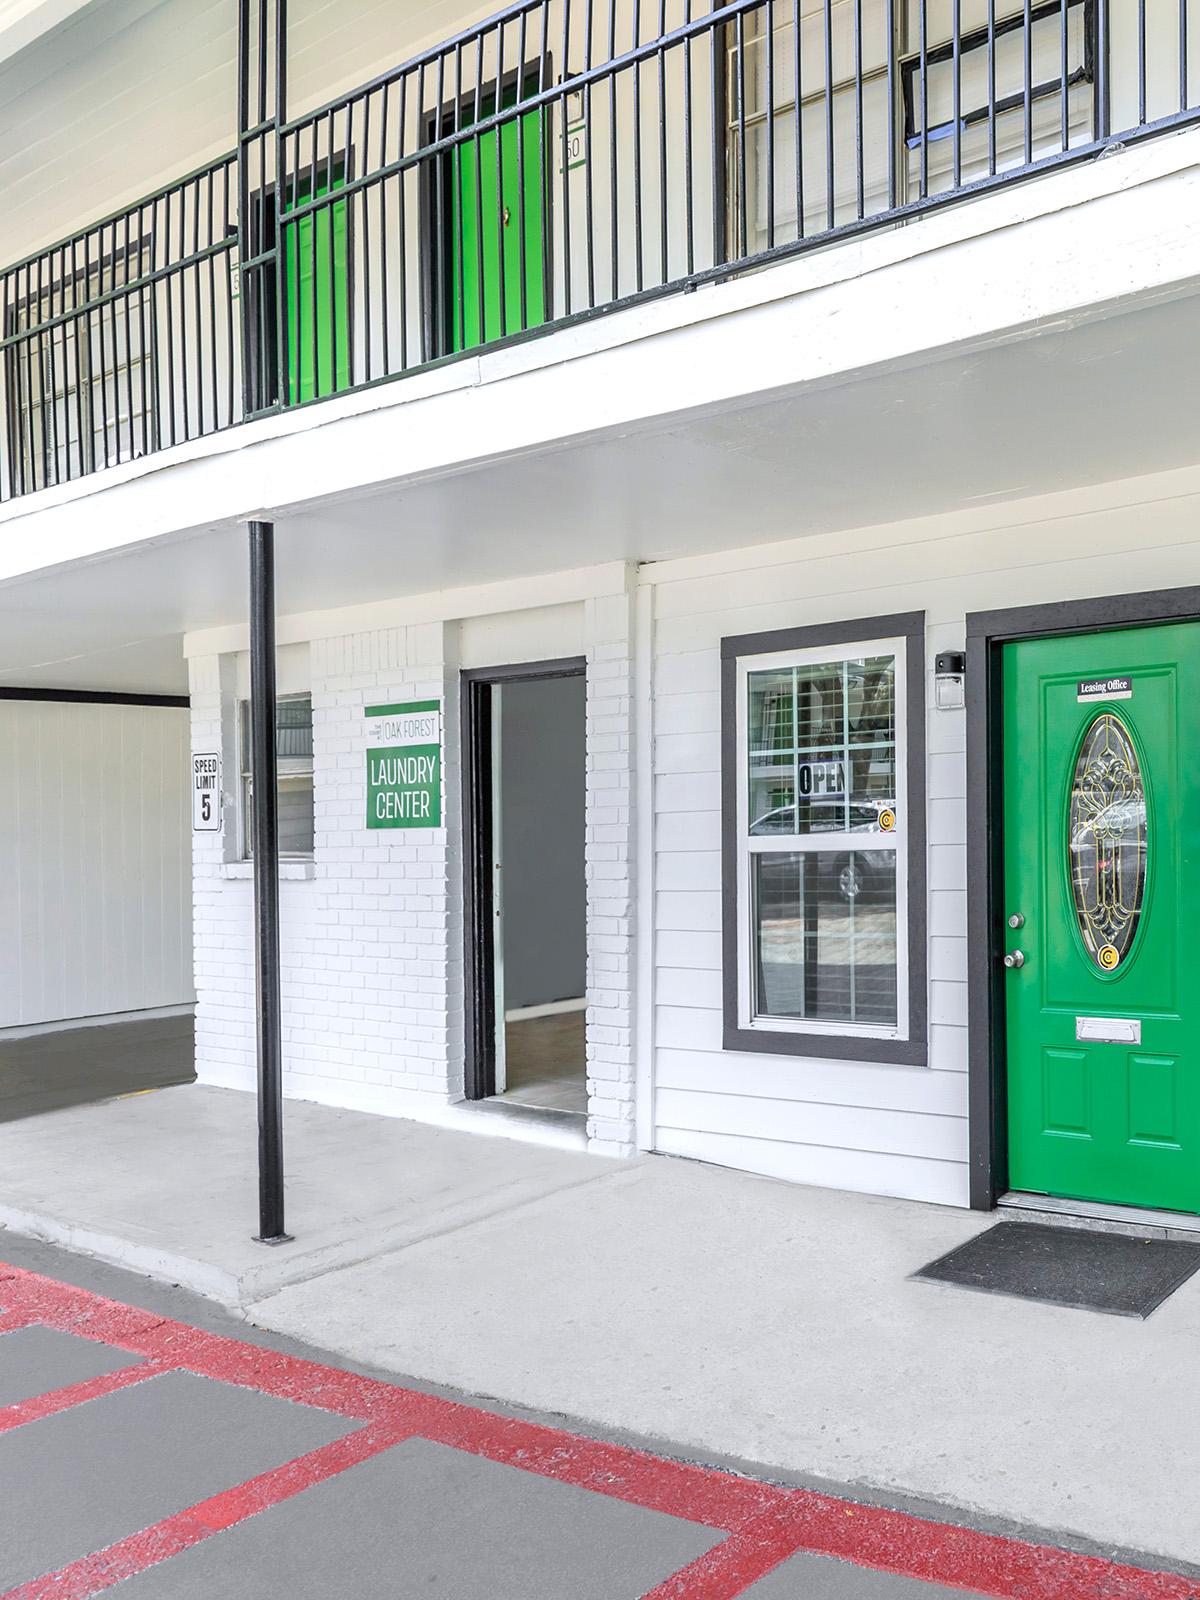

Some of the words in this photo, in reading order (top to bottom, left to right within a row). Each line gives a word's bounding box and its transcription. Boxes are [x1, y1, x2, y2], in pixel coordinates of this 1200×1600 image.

[1080, 682, 1107, 694] Leasing
[1107, 679, 1128, 690] Office
[385, 722, 402, 740] OAK
[404, 718, 435, 739] FOREST
[194, 759, 217, 773] SPEED
[371, 755, 436, 786] LAUNDRY
[196, 775, 216, 790] LIMIT
[799, 763, 846, 795] OPEN
[201, 793, 211, 822] 5
[376, 790, 430, 819] CENTER
